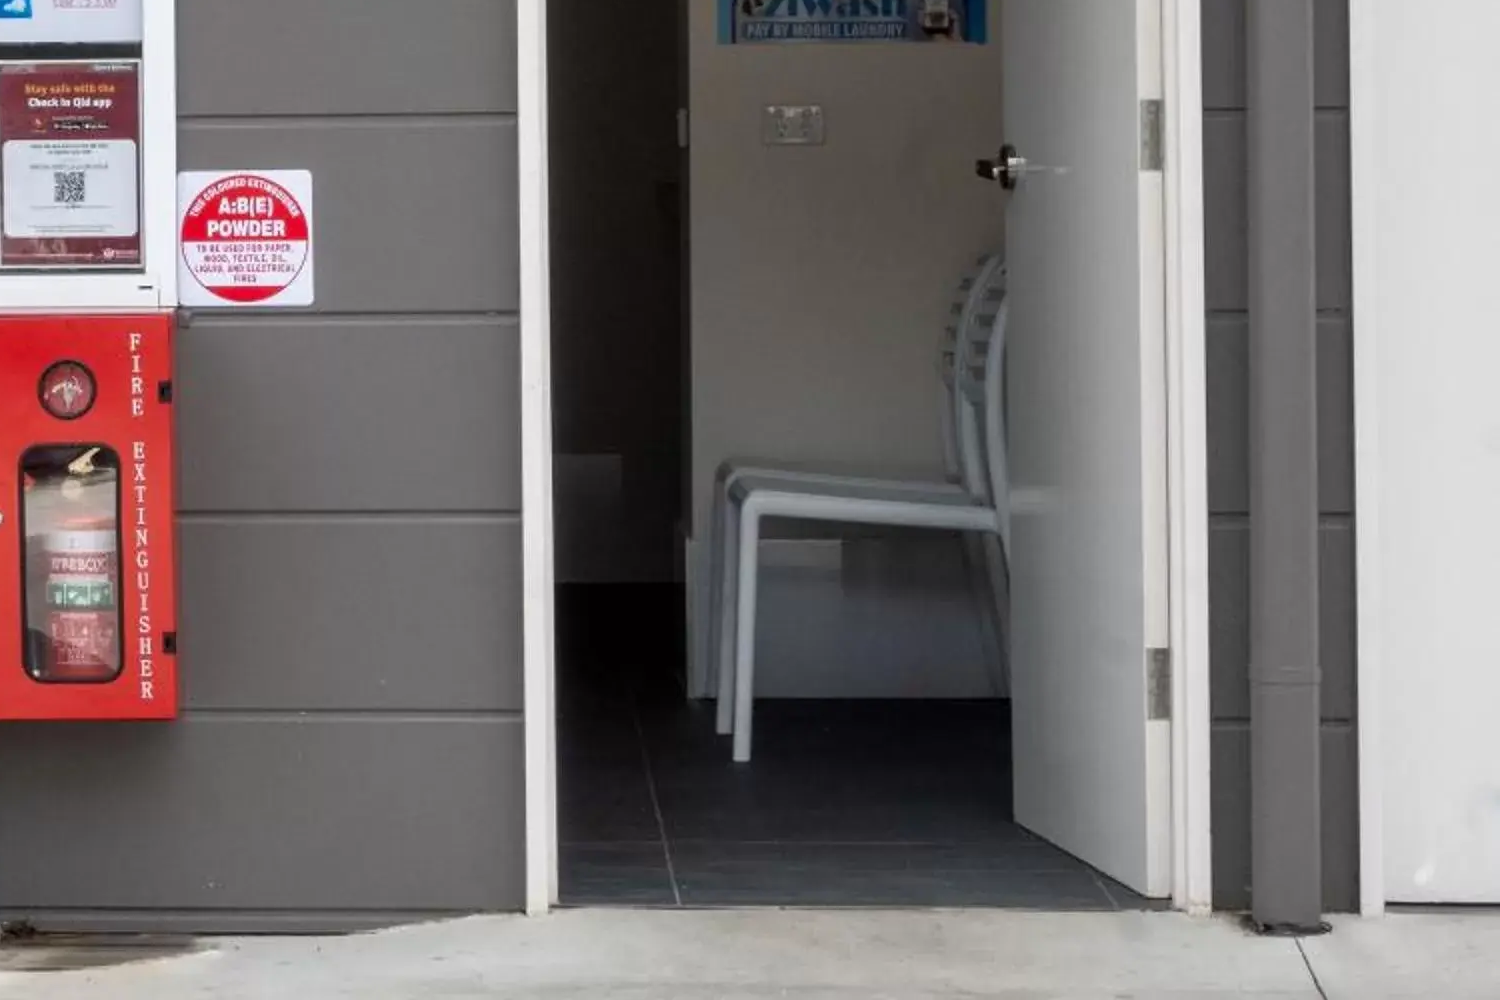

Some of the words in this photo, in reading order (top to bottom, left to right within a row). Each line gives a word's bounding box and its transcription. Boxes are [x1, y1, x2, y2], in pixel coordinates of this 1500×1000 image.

[746, 23, 771, 38] PAY
[772, 23, 790, 37] BY
[792, 23, 839, 37] MOBILE
[842, 22, 904, 37] LAUNDRY
[24, 83, 48, 95] Stay
[49, 83, 71, 94] safe
[73, 82, 98, 93] with
[99, 82, 116, 93] the
[27, 98, 59, 108] Check
[73, 98, 92, 109] Qld
[92, 99, 113, 109] app
[218, 195, 275, 217] A:B(E)
[206, 218, 286, 238] POWDER
[196, 243, 208, 253] TO
[209, 243, 220, 253] BE
[222, 243, 245, 253] USED
[245, 243, 263, 253] FOR
[226, 263, 245, 273] AND
[245, 263, 296, 273] ELECTRICAL
[232, 274, 257, 284] FIRES
[128, 332, 145, 417] FIRE
[131, 441, 155, 700] EXTINGUISHER
